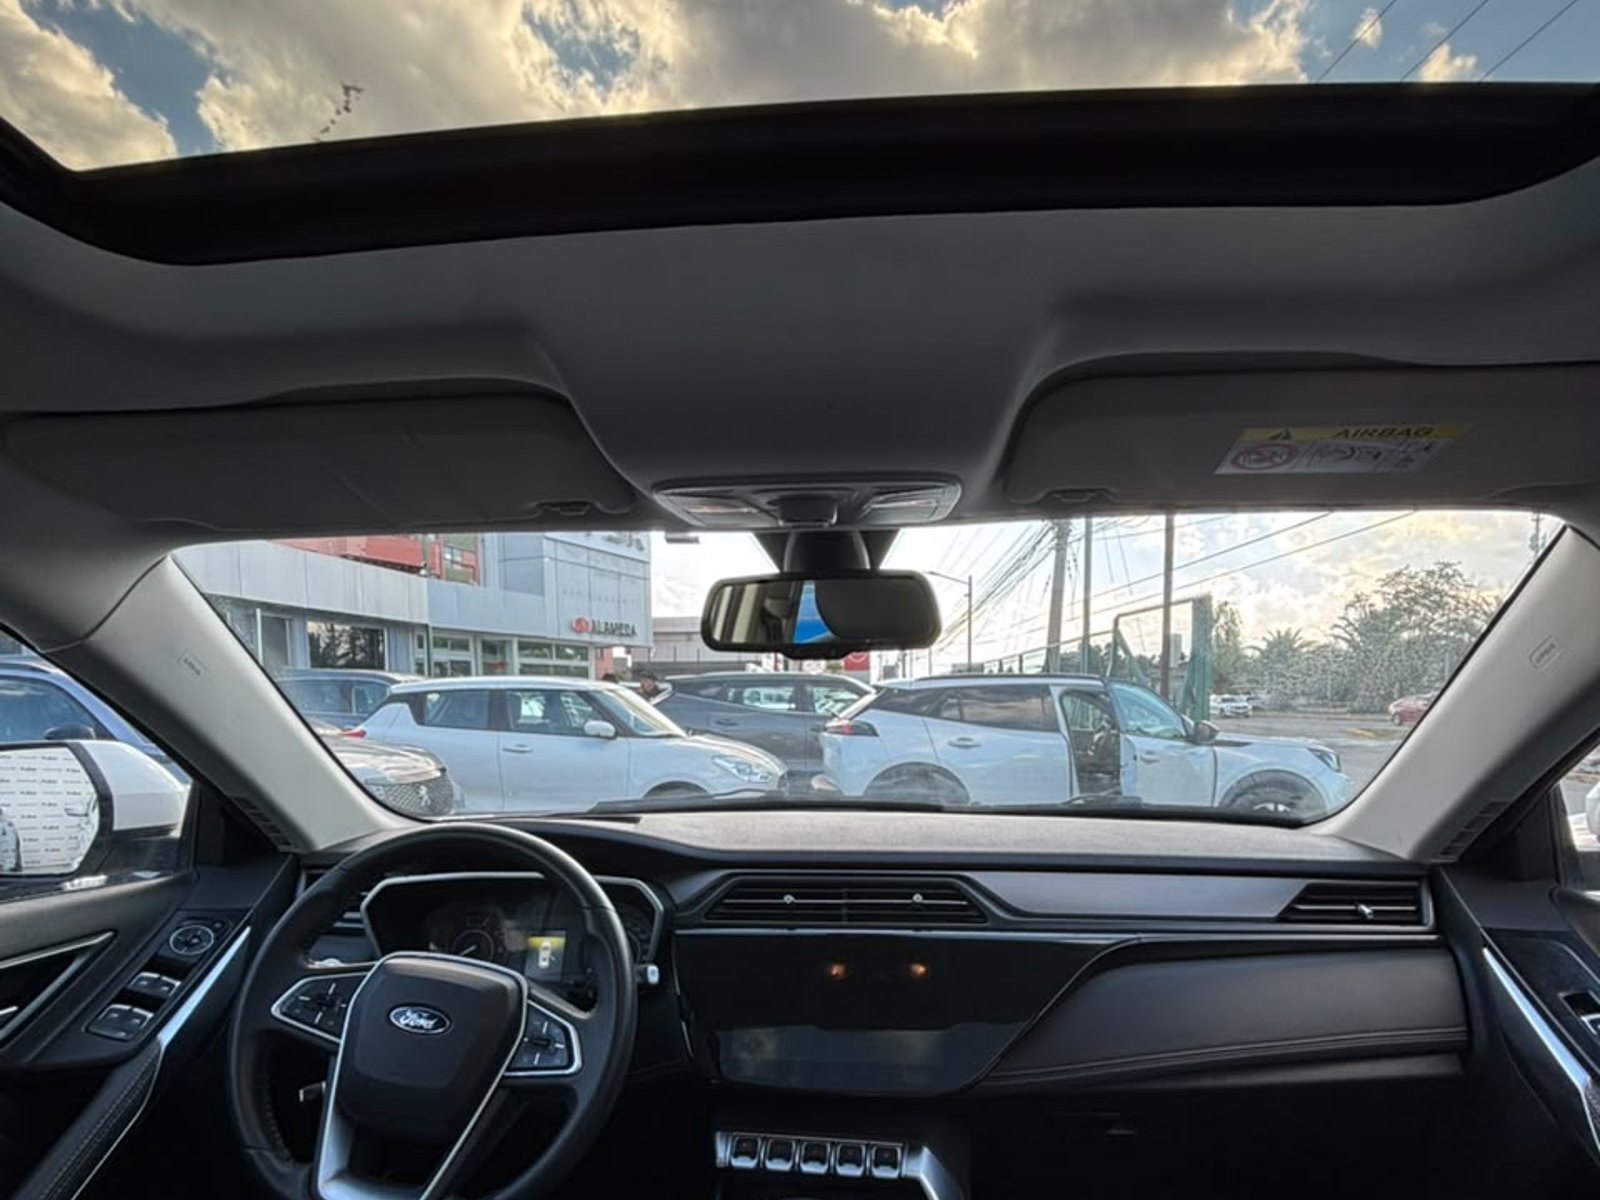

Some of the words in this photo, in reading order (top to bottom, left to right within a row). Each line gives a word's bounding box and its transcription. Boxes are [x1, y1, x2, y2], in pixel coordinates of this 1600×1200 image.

[1332, 423, 1433, 439] AIRBAG
[591, 619, 637, 638] ALAMEDA
[399, 1008, 438, 1030] Ford
